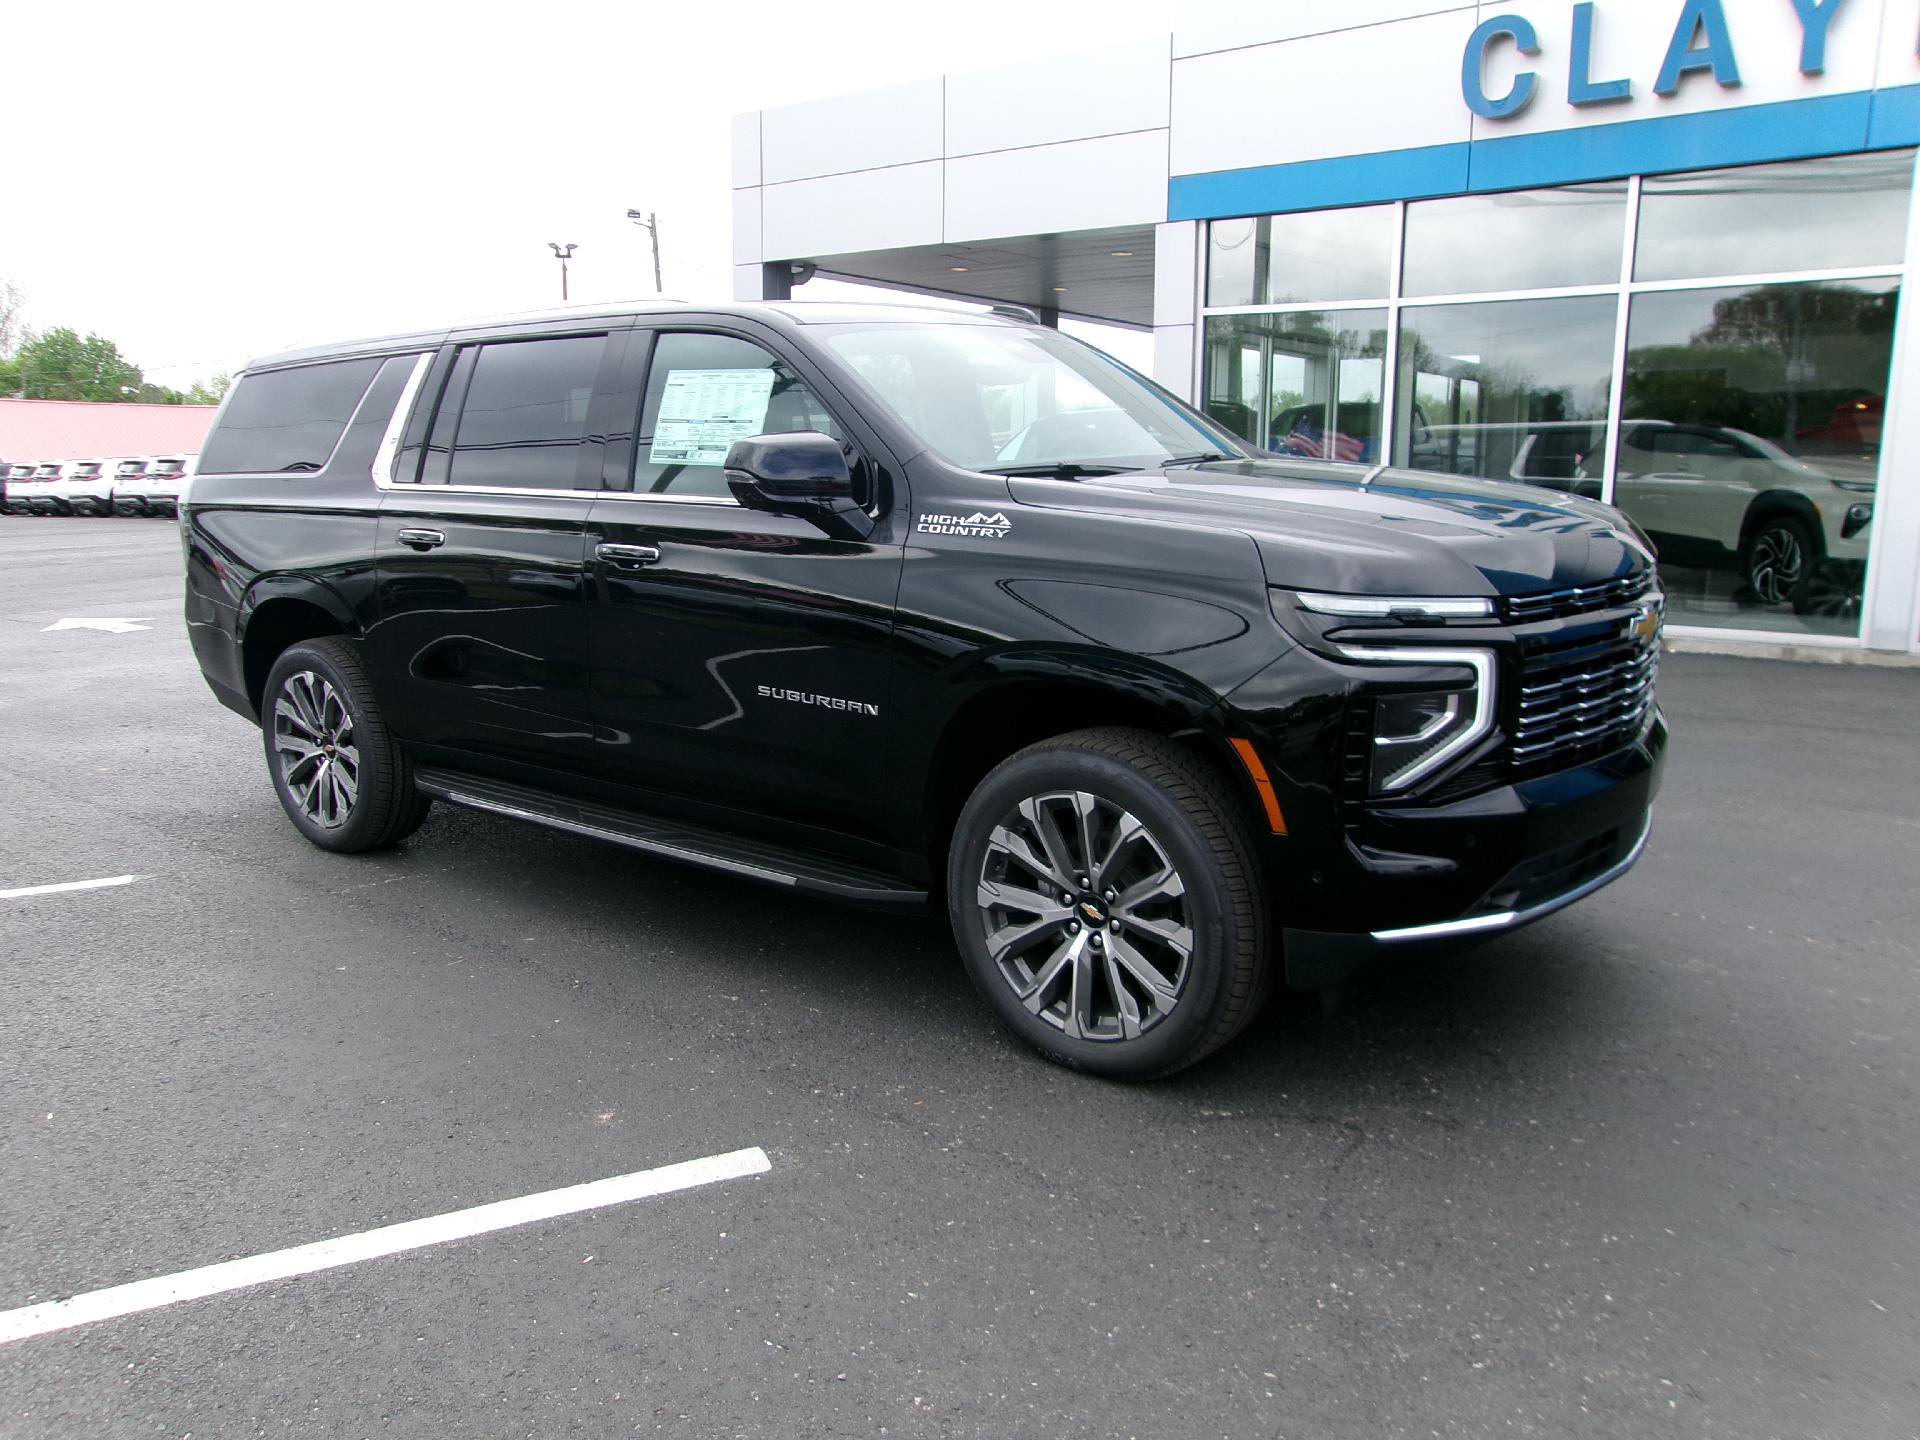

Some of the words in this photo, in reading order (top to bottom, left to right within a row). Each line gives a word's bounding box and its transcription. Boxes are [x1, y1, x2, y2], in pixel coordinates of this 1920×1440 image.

[1462, 0, 1920, 120] CLAY
[919, 513, 966, 525] HIGH
[917, 523, 1011, 539] COUNTRY
[757, 685, 879, 716] SUBURBAN
